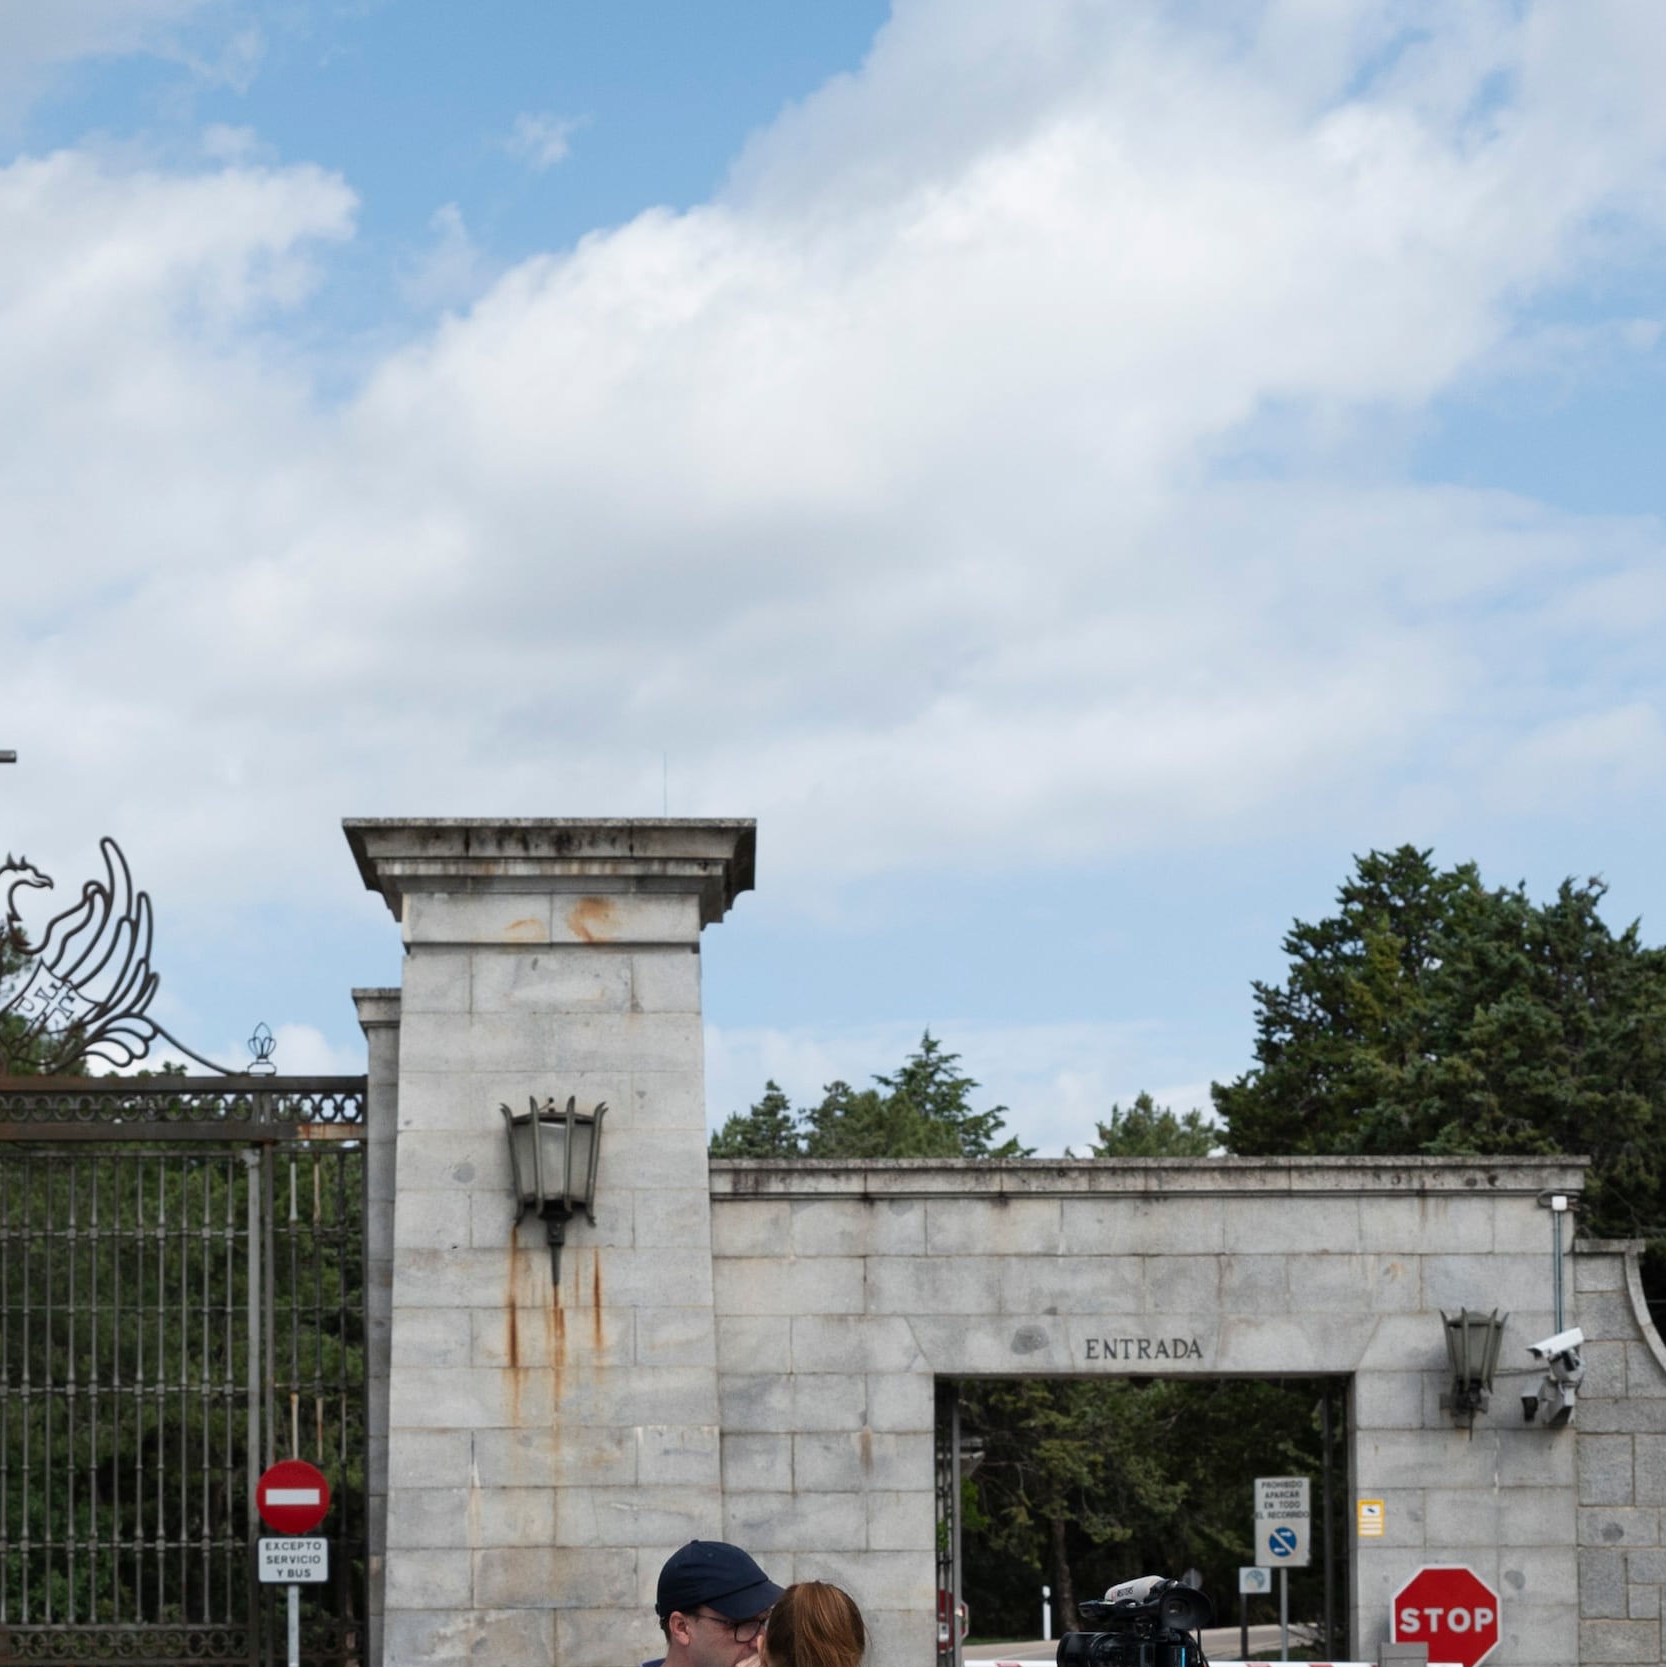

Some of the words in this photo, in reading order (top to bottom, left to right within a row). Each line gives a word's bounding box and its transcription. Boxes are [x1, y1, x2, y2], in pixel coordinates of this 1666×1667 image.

[1085, 1337, 1204, 1360] ENTRADA
[1261, 1480, 1303, 1489] PROHIBIDO
[1265, 1490, 1300, 1499] APARCAR
[1264, 1501, 1274, 1510] EN
[1279, 1500, 1301, 1509] TODO
[1268, 1510, 1310, 1519] RECORRIDO
[265, 1541, 322, 1551] EXCEPTO
[266, 1554, 321, 1565] SERVICIO
[276, 1568, 284, 1578] Y
[287, 1568, 311, 1578] BUS
[1399, 1607, 1494, 1633] STOP
